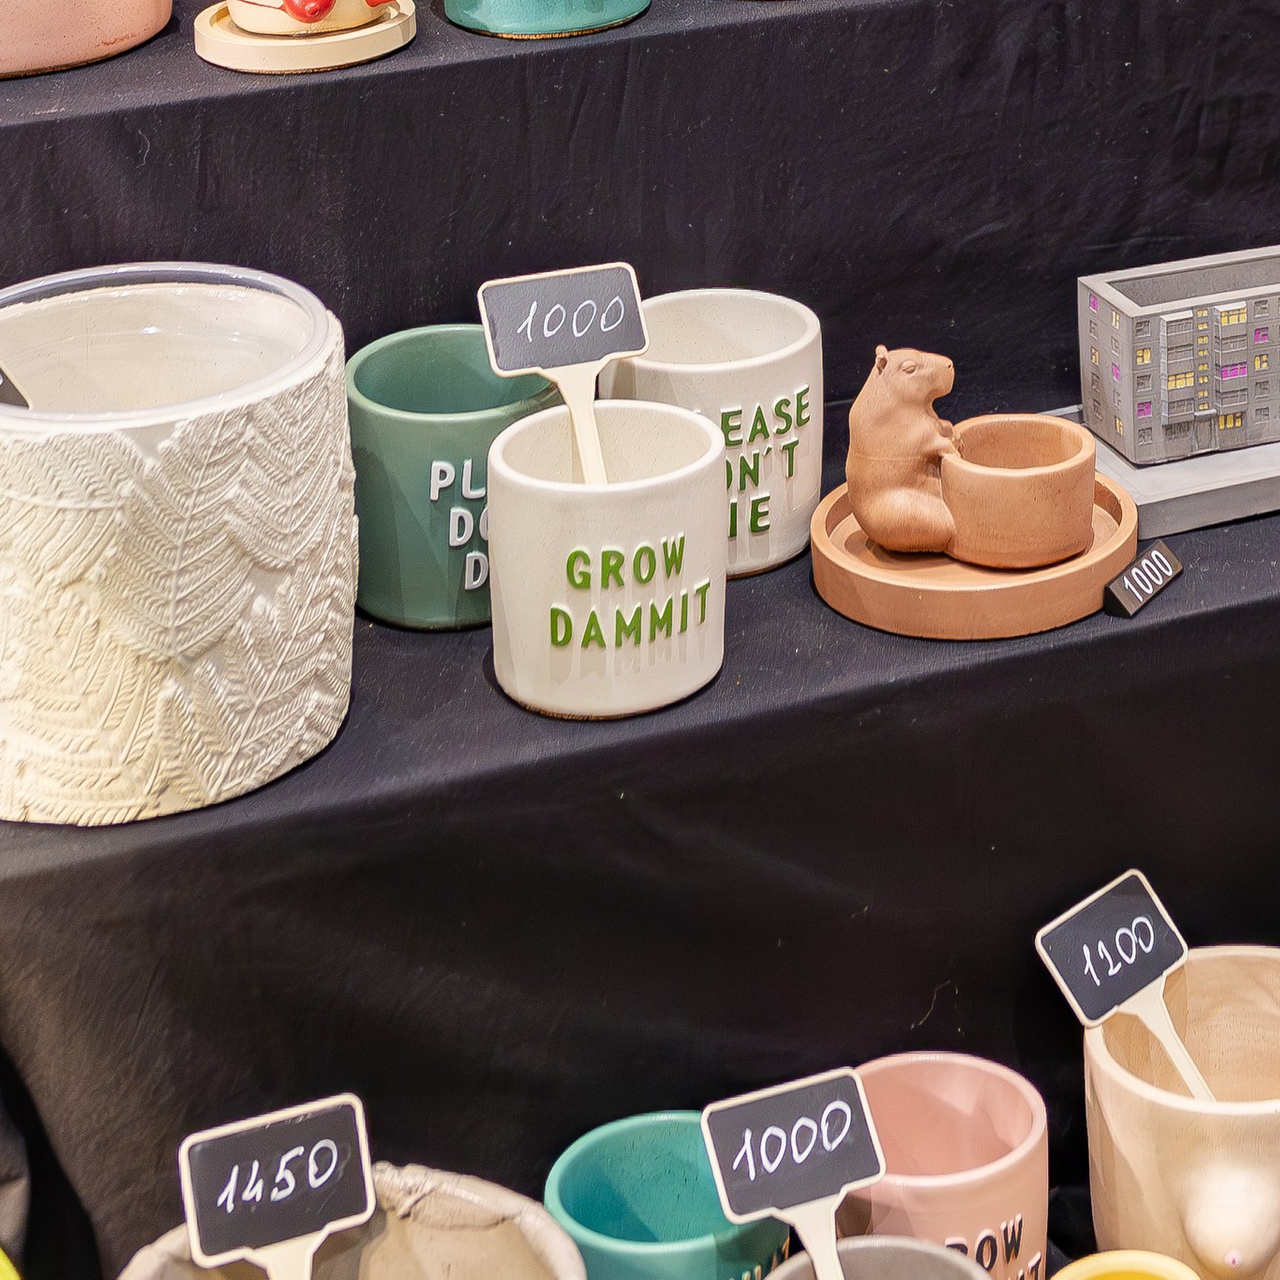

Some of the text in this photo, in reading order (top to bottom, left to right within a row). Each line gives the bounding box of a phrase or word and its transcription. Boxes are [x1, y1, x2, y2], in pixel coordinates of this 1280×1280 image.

[517, 293, 626, 344] 1000
[720, 383, 811, 447] EASE
[726, 493, 773, 539] IE
[565, 532, 686, 590] GROW
[1122, 547, 1175, 605] 1000
[549, 578, 712, 651] DAMMIT
[731, 1099, 852, 1181] 1000
[216, 1136, 340, 1214] 1450
